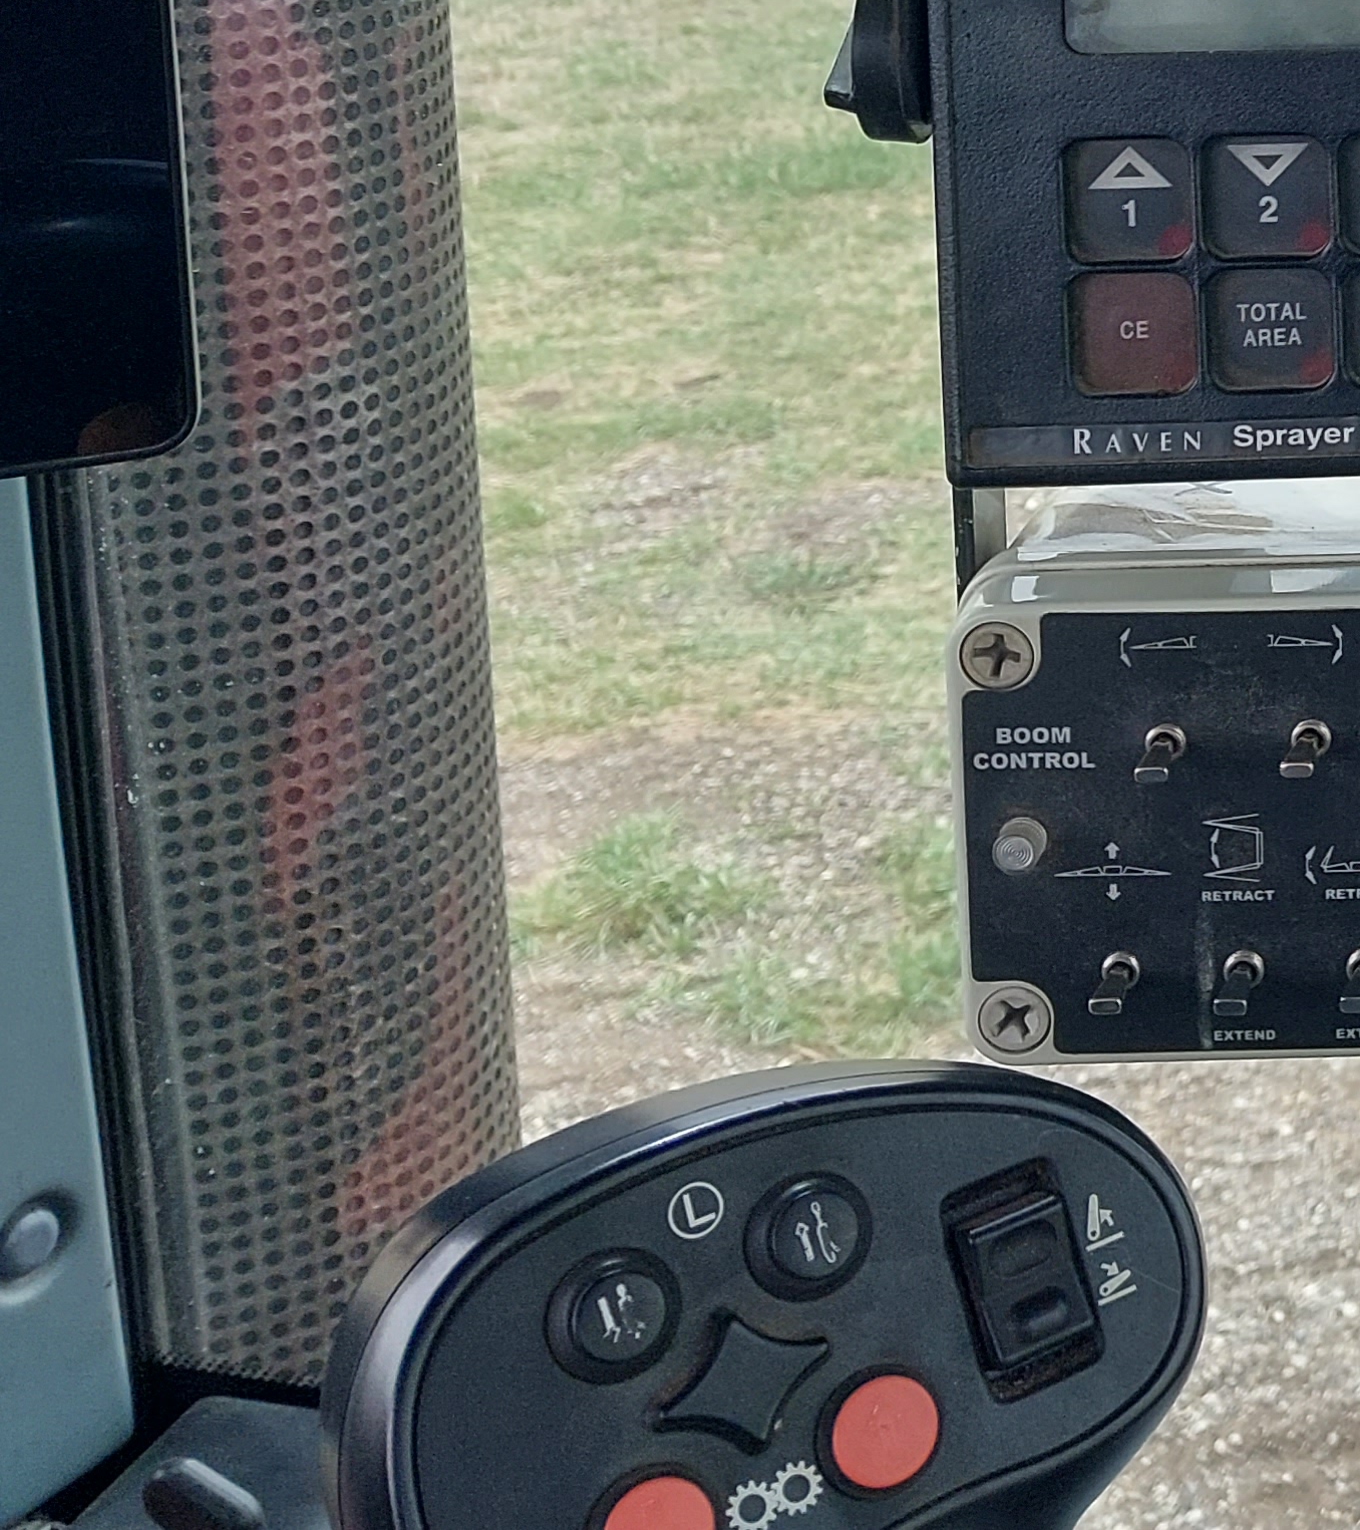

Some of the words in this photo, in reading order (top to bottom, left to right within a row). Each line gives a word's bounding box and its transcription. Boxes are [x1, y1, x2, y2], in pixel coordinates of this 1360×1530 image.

[1121, 199, 1136, 227] 1
[1258, 195, 1279, 223] 2
[1236, 302, 1307, 322] TOTAL
[1119, 320, 1150, 340] CE
[1243, 327, 1302, 347] AREA
[1074, 429, 1201, 455] RAVEN
[1233, 424, 1355, 452] Sprayer
[996, 726, 1071, 744] BOOM
[973, 751, 1096, 770] CONTROL
[1201, 889, 1276, 902] RETRACT
[1213, 1029, 1276, 1042] EXTEND
[682, 1193, 716, 1228] L
